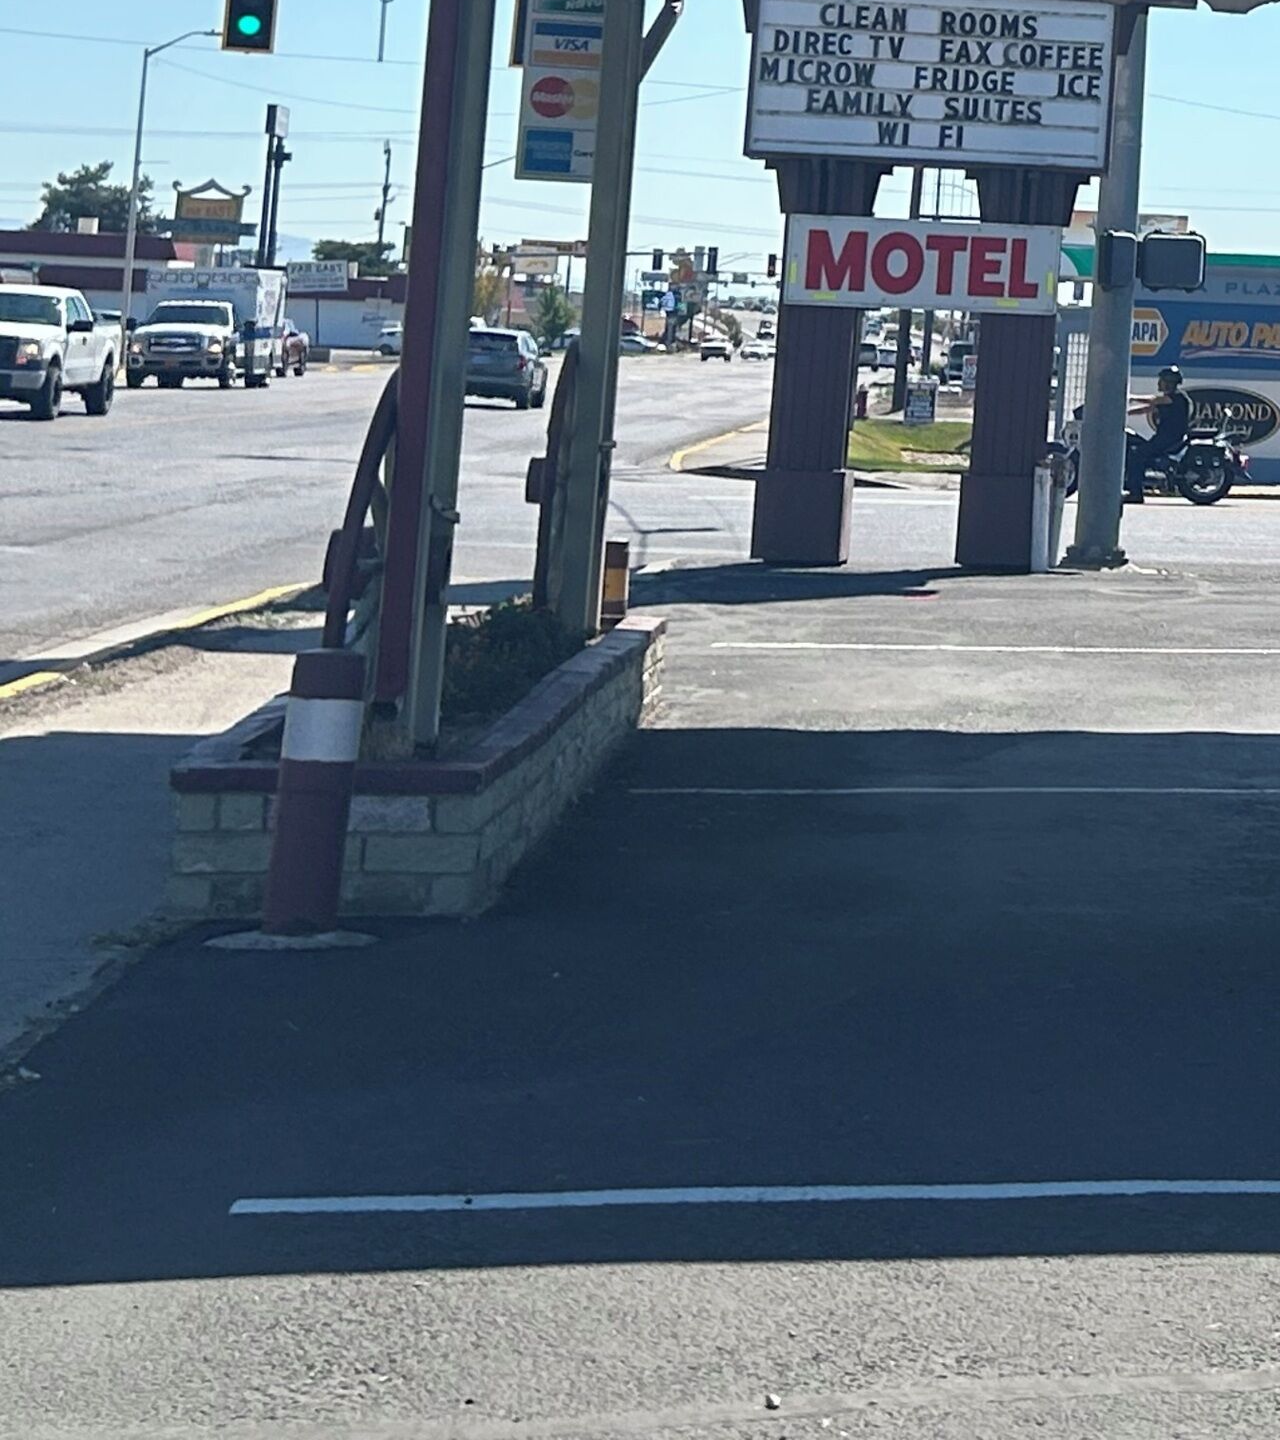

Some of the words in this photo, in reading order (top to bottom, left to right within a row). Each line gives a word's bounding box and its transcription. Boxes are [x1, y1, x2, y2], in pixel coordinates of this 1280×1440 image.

[819, 3, 907, 32] CLEAN
[940, 11, 1038, 38] ROOMS
[555, 38, 589, 52] VISA
[773, 29, 853, 56] DIREC
[869, 35, 905, 59] TV
[939, 39, 993, 65] FAX
[1003, 42, 1103, 71] COFFEE
[759, 57, 876, 87] MICROW
[914, 66, 1016, 95] FRIDGE
[1056, 73, 1101, 101] ICE
[805, 88, 914, 117] FAMILY
[944, 96, 1043, 124] SUITES
[877, 121, 911, 146] WI
[938, 125, 964, 148] FI
[804, 228, 1039, 299] MOTEL
[1132, 320, 1158, 343] APA
[1181, 319, 1250, 347] AUTO
[1186, 398, 1272, 421] IAMOND
